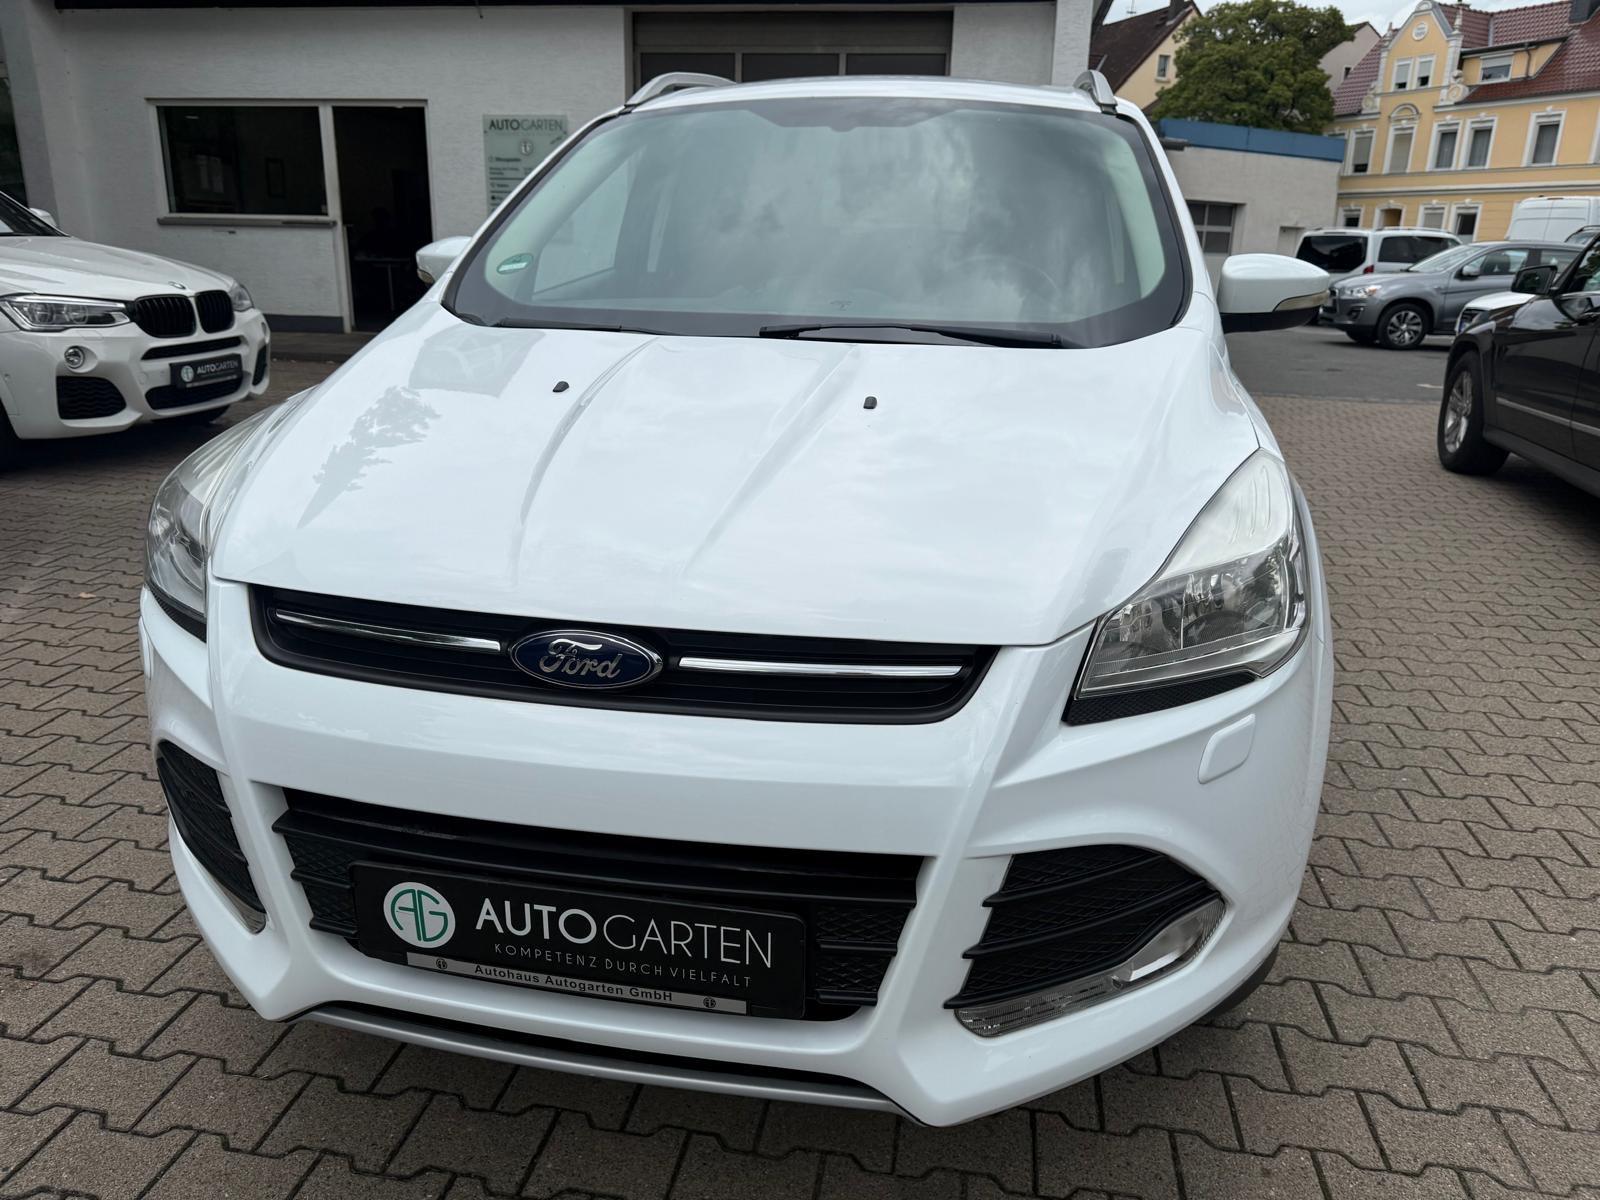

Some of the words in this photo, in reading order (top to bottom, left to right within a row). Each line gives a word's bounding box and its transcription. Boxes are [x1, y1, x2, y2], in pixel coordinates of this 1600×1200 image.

[489, 119, 562, 131] AUTOGARTEN
[539, 638, 623, 678] Ford
[390, 888, 449, 943] AG
[475, 897, 772, 969] AUTOGARTEN
[474, 964, 540, 984] Autohaus
[544, 975, 624, 996] Autogarten
[629, 987, 673, 1001] GmbH
[494, 943, 598, 969] KOMPETENZ
[605, 958, 662, 977] DURCH
[670, 966, 751, 988] VIELFALT
